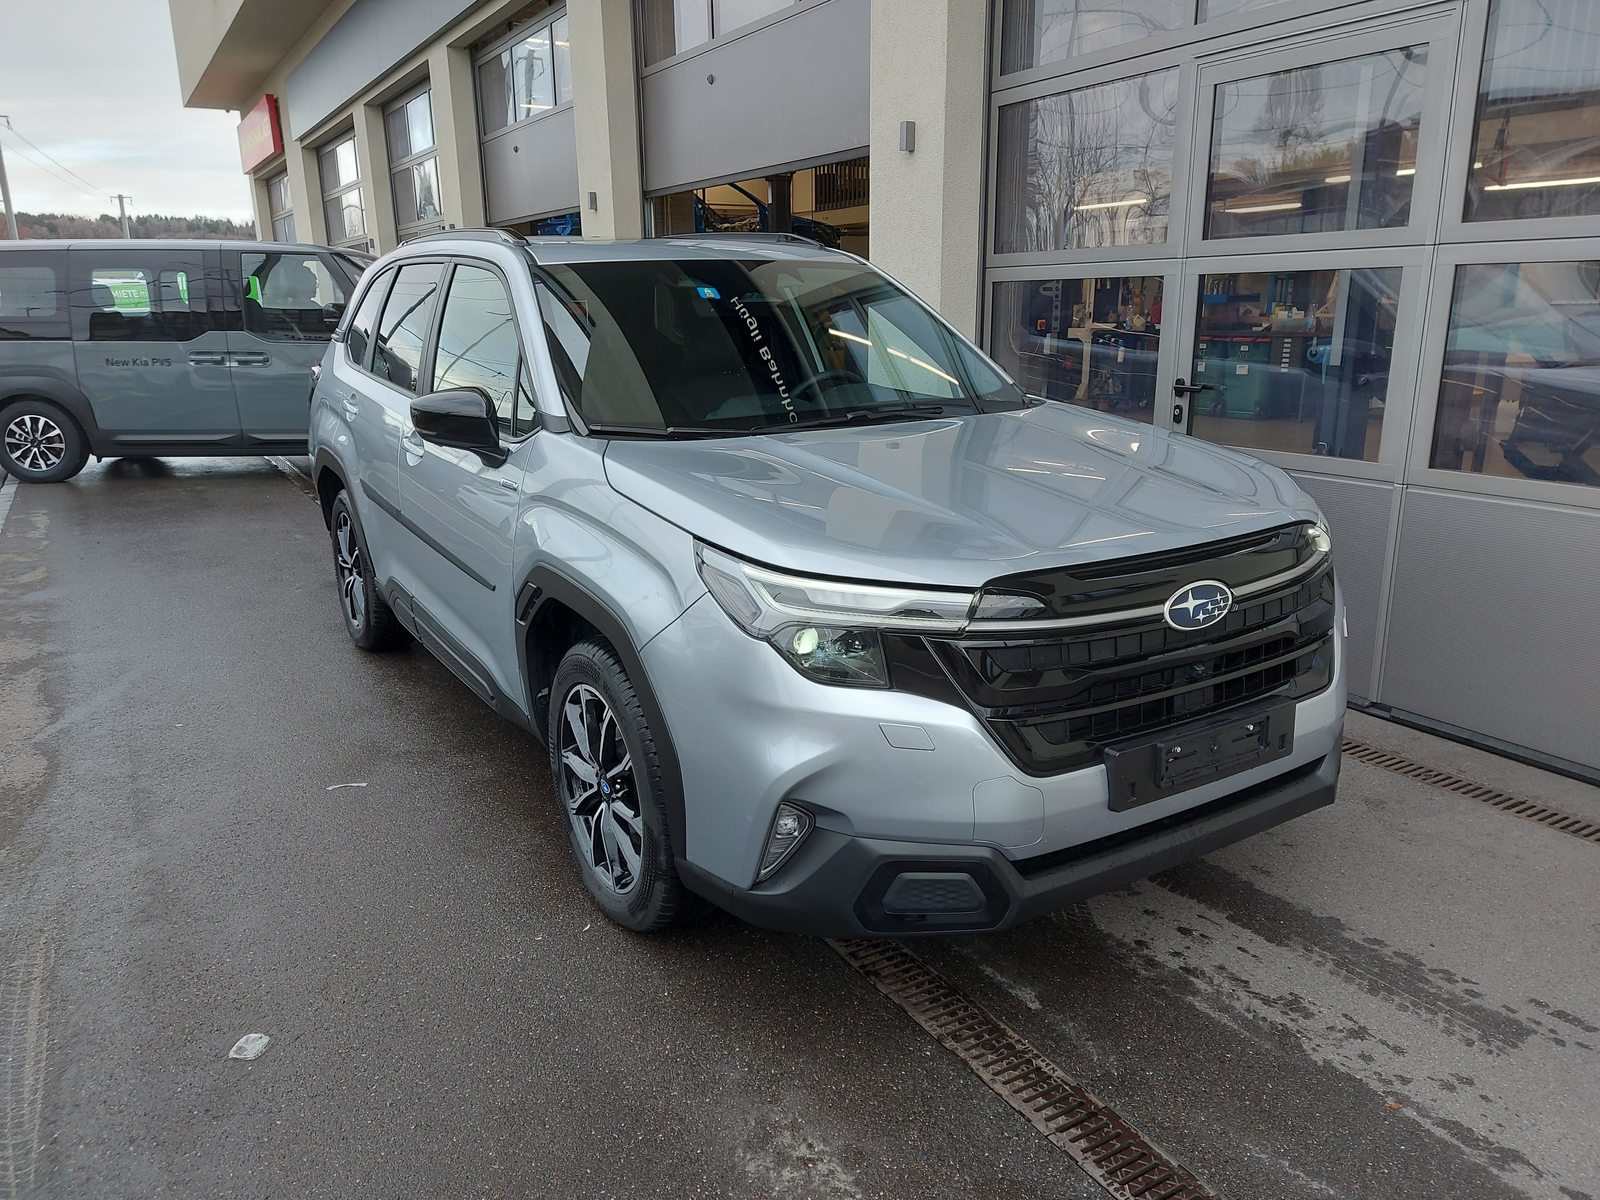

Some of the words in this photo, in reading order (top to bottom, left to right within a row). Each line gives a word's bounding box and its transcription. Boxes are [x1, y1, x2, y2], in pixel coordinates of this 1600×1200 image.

[105, 358, 129, 367] New
[132, 358, 149, 367] Kia
[152, 358, 171, 367] PV5
